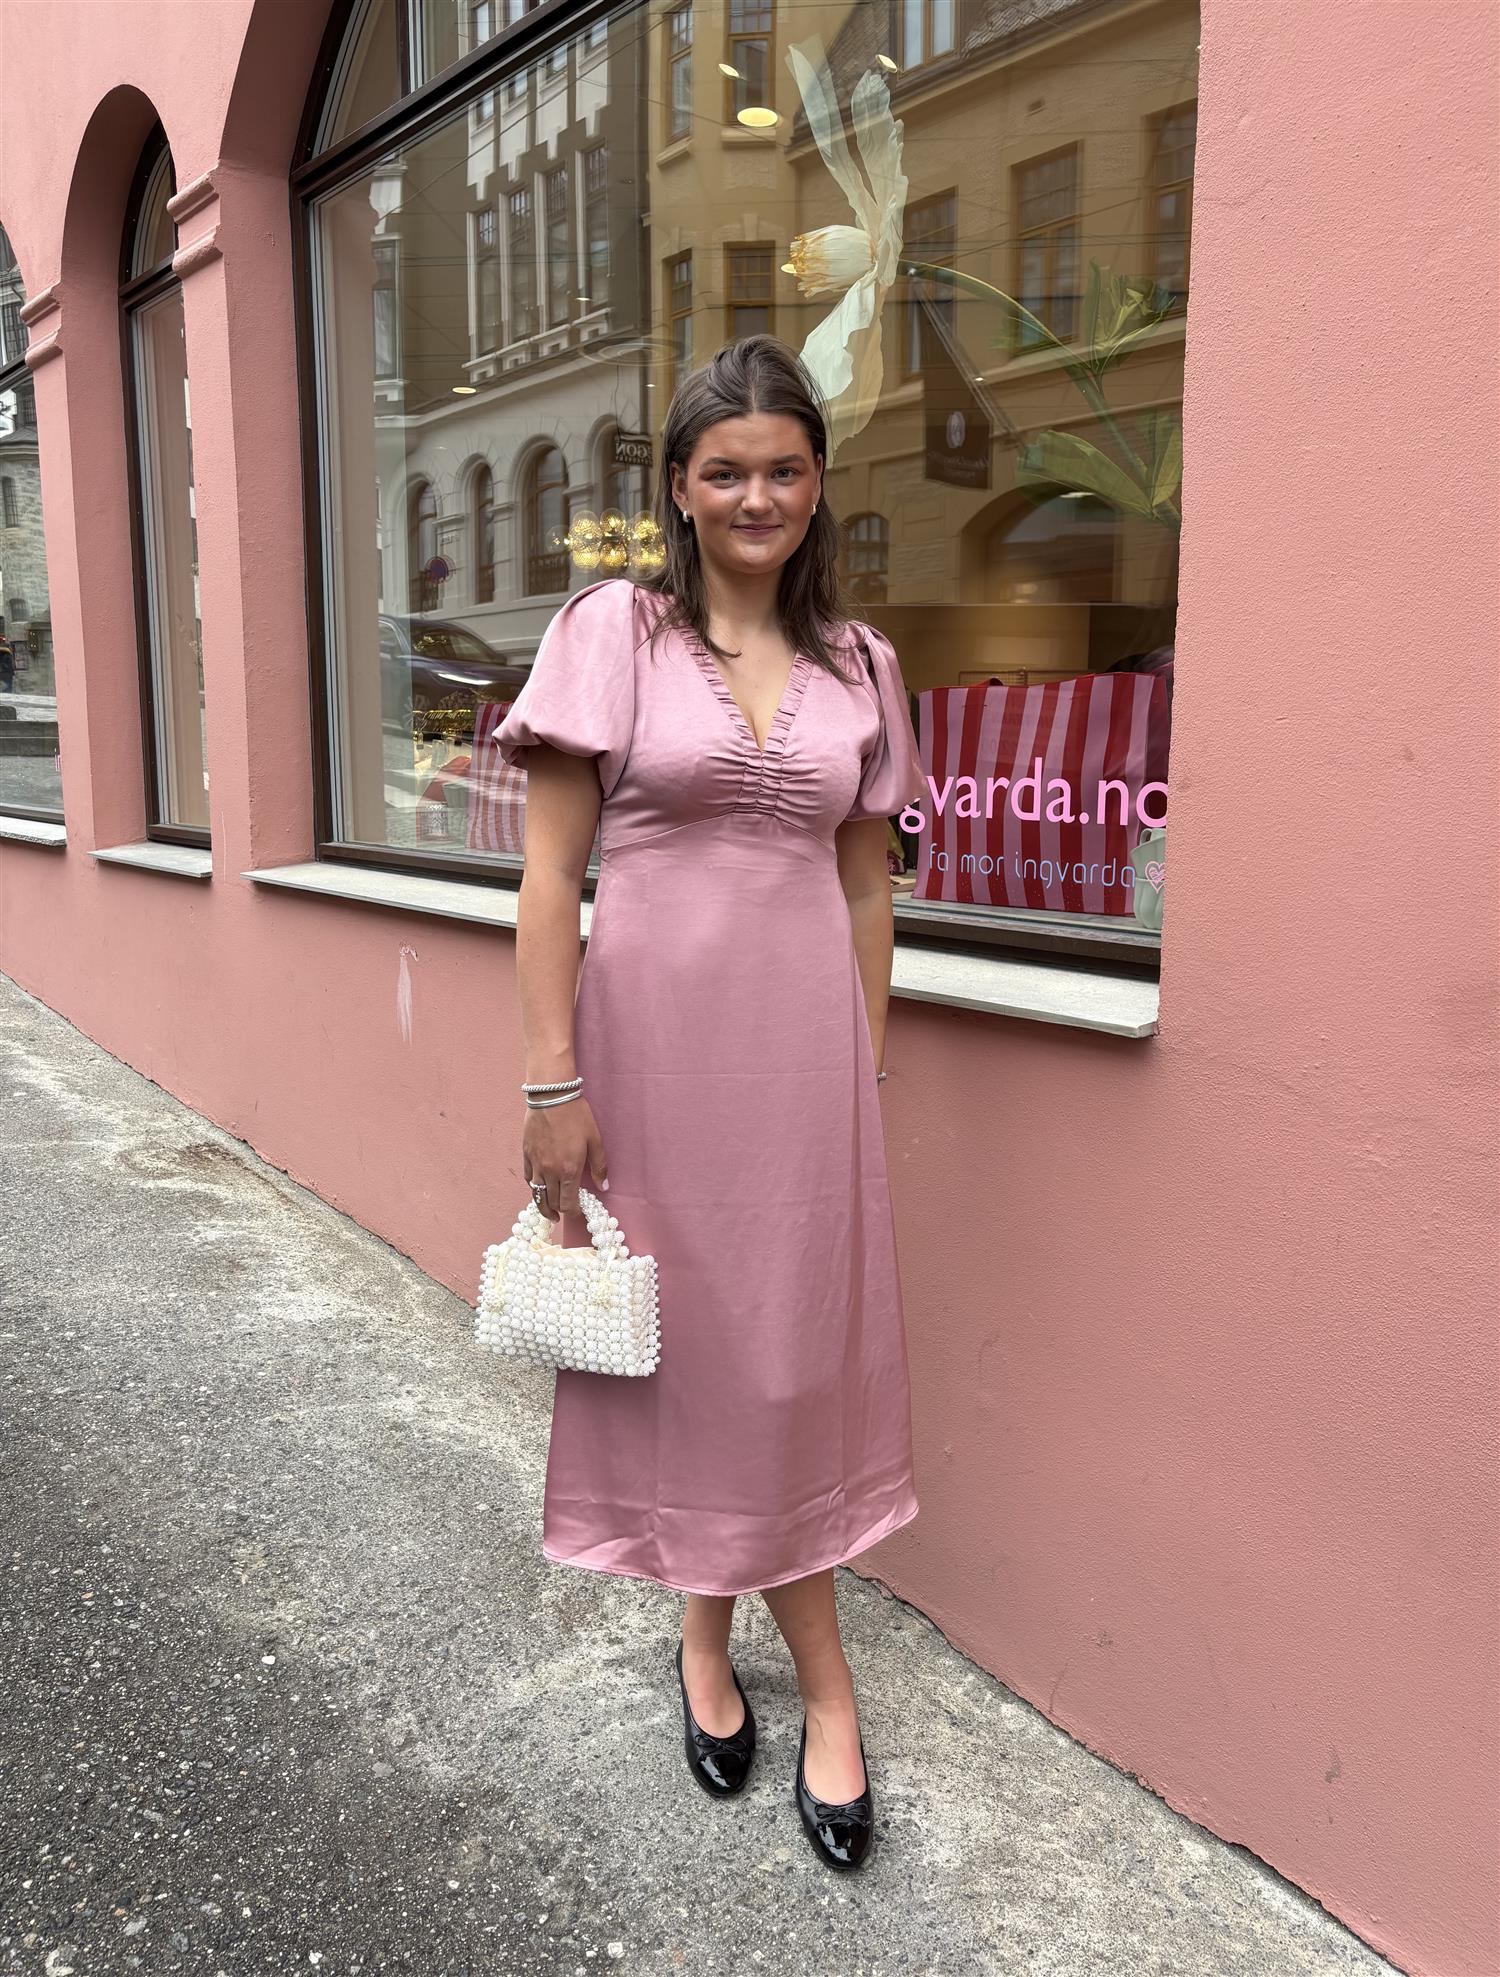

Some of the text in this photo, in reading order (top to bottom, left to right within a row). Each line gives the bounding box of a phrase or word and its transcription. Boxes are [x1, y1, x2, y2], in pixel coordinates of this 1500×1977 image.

[929, 843, 1135, 889] fa mor ingvarda
